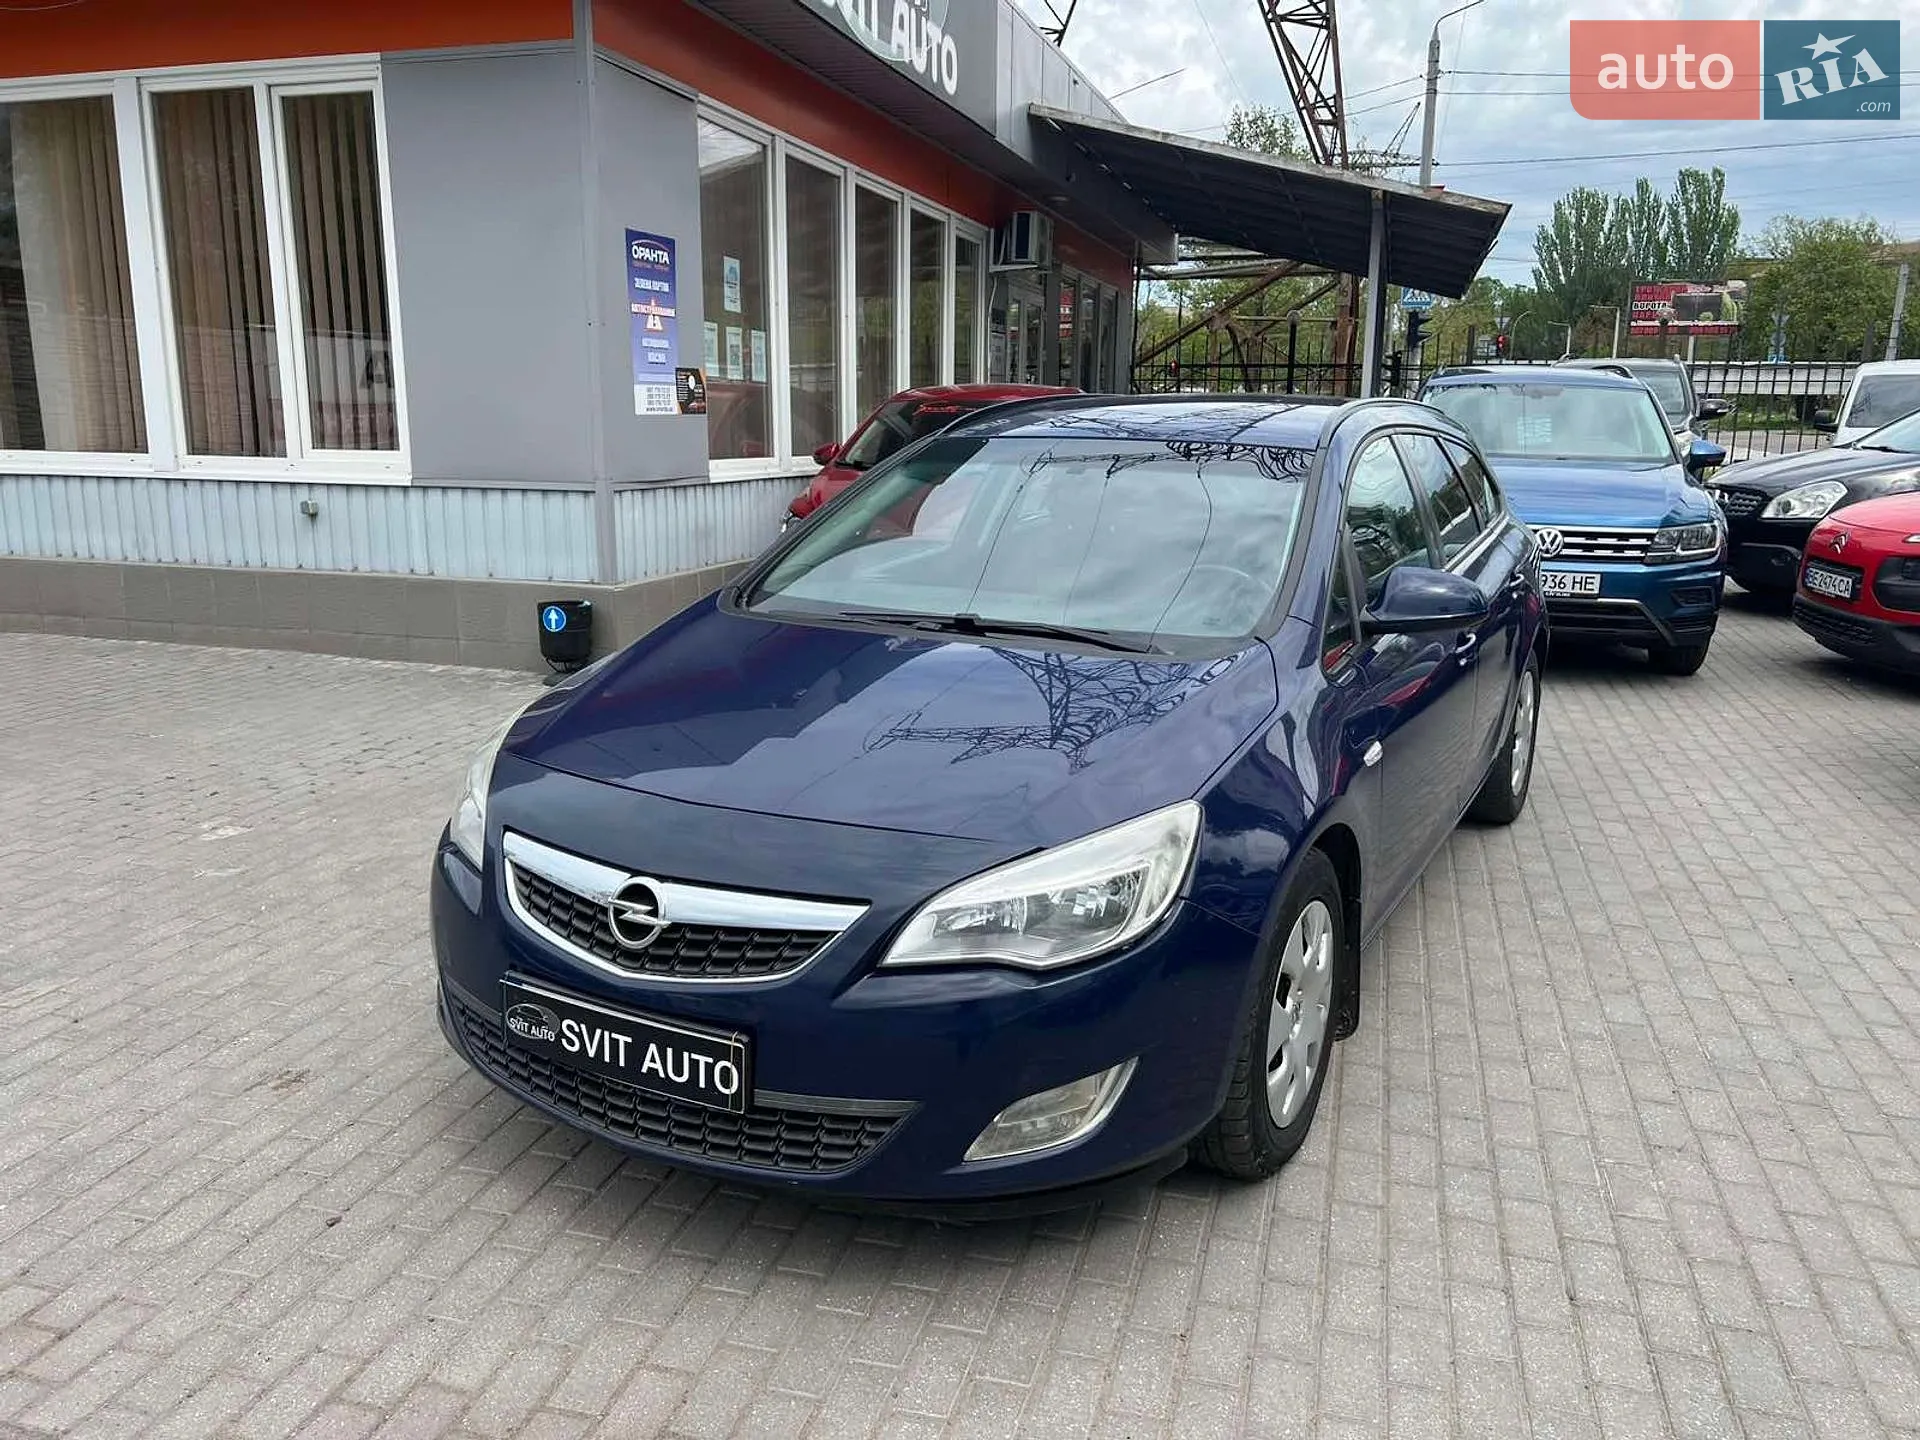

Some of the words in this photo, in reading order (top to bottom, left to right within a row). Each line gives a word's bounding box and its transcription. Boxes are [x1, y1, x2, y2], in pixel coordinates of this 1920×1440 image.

[890, 0, 958, 96] AUTO
[631, 244, 670, 265] ОРАНТА
[509, 1016, 530, 1033] SVIT
[530, 1025, 555, 1042] AUTO
[561, 1018, 632, 1067] SVIT
[640, 1043, 739, 1095] AUTO
